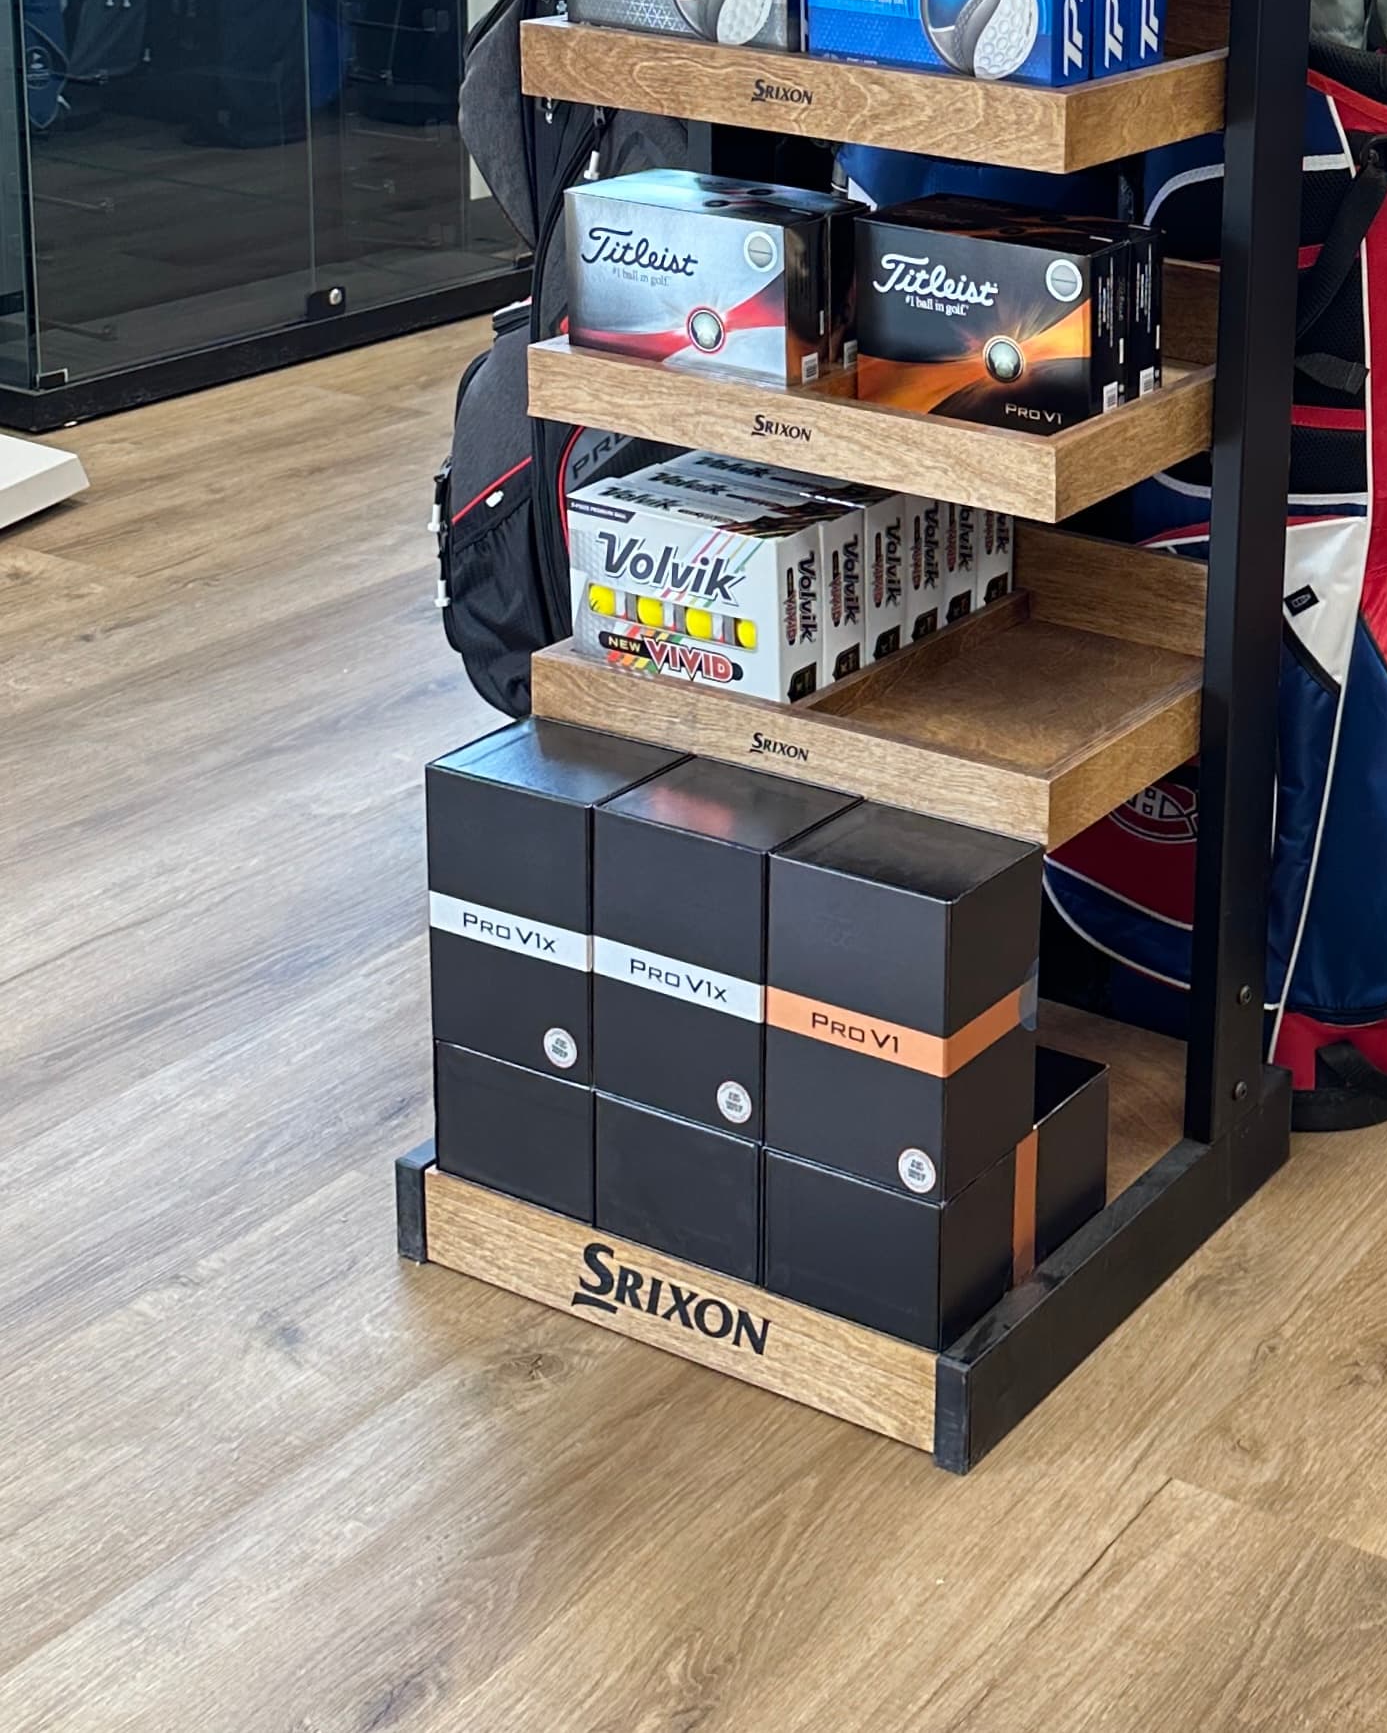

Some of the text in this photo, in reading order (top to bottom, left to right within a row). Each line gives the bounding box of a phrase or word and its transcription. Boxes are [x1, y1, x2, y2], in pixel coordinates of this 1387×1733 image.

[751, 77, 813, 105] SRIXON
[581, 226, 698, 277] Titleist
[872, 253, 998, 306] Titleist
[916, 297, 934, 311] ball
[935, 302, 945, 313] in
[751, 414, 812, 442] SRIXON
[597, 531, 744, 602] Volvik
[886, 516, 901, 608] Volvik
[923, 501, 940, 590] Volvik
[798, 550, 817, 644] Volvik
[843, 533, 862, 626] Volvik
[608, 635, 734, 683] NEW VIVID
[750, 732, 809, 761] SRIXON
[573, 1242, 772, 1357] SRIXON
